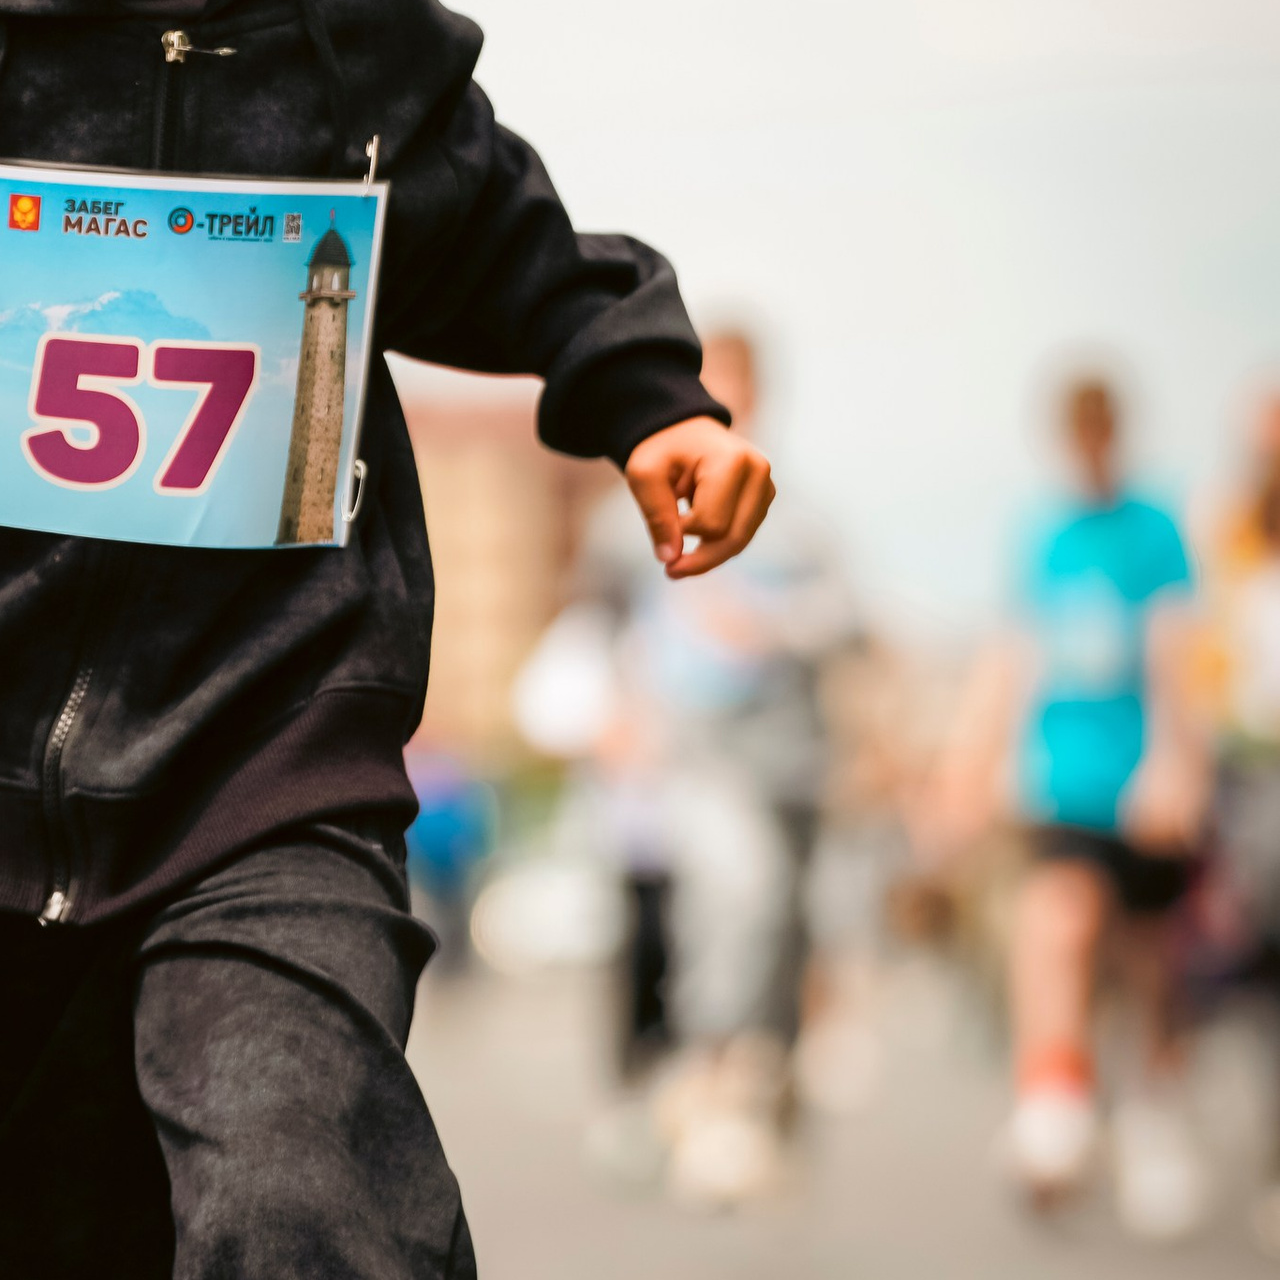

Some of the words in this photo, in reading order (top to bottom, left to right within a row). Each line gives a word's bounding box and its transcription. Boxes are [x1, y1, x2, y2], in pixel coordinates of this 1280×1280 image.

[64, 198, 124, 216] ЗАБЕГ
[62, 215, 148, 238] МАГАС
[26, 337, 257, 490] 57
